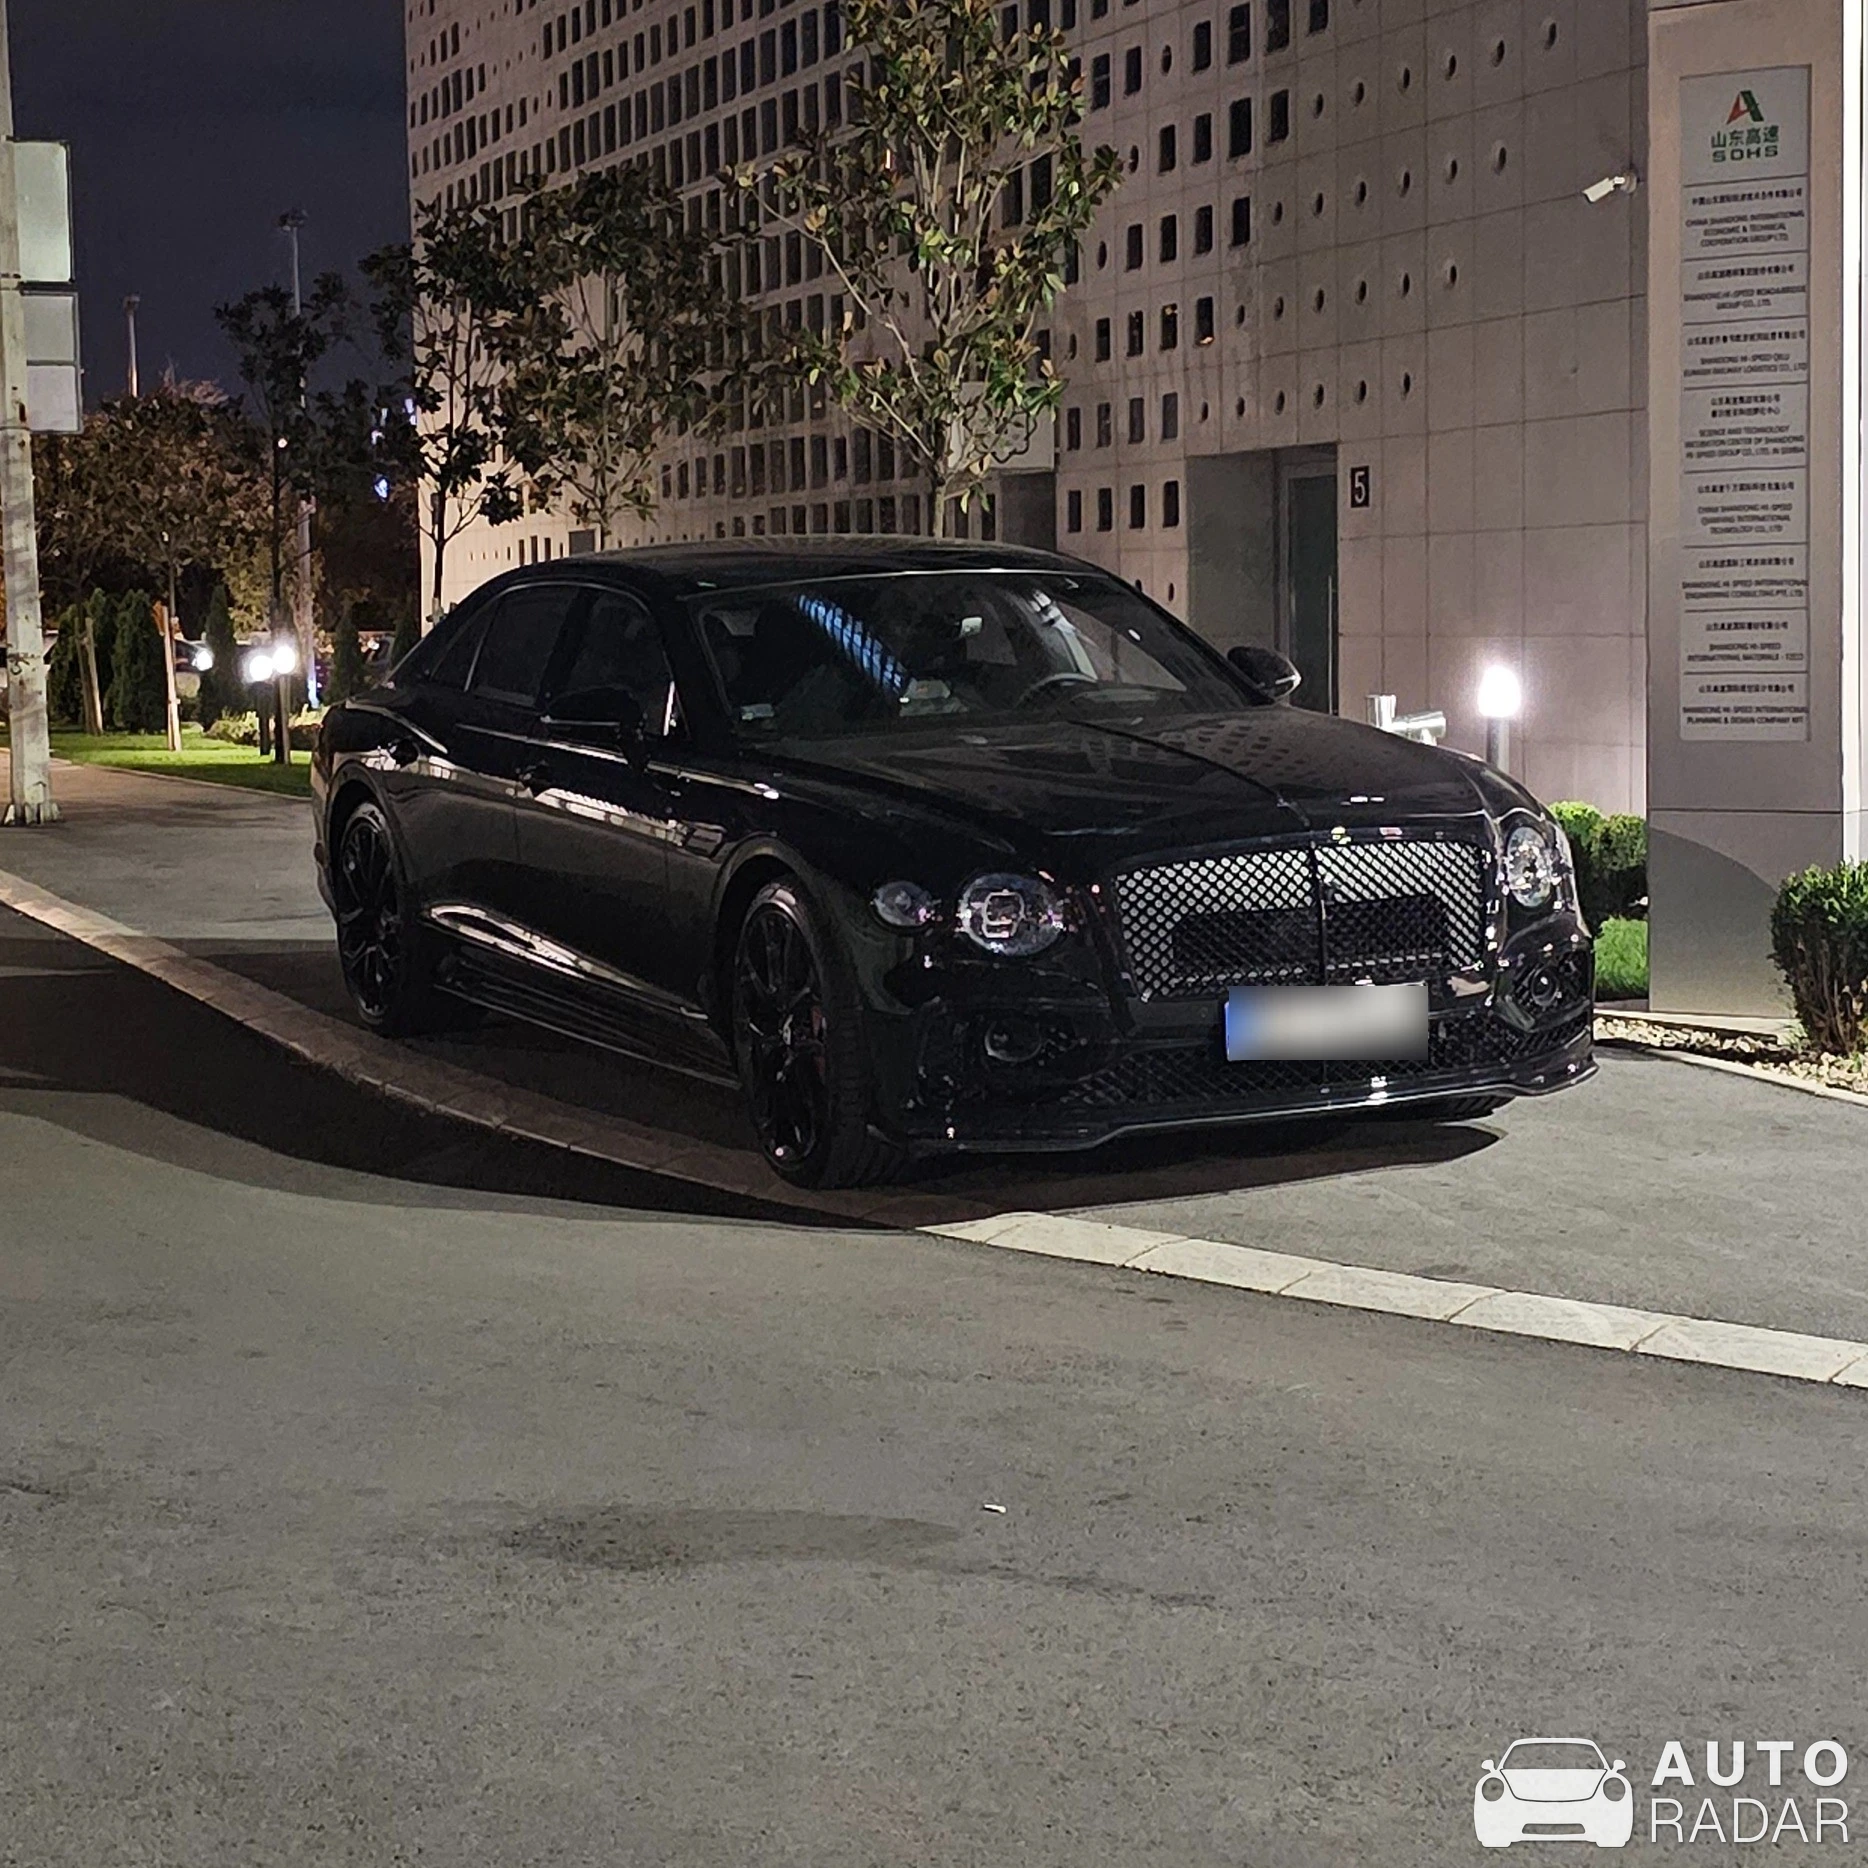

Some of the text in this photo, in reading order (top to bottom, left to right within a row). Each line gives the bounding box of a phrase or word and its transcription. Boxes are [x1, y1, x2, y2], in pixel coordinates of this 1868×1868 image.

[1711, 125, 1779, 148] 山东高速
[1354, 471, 1366, 503] 5
